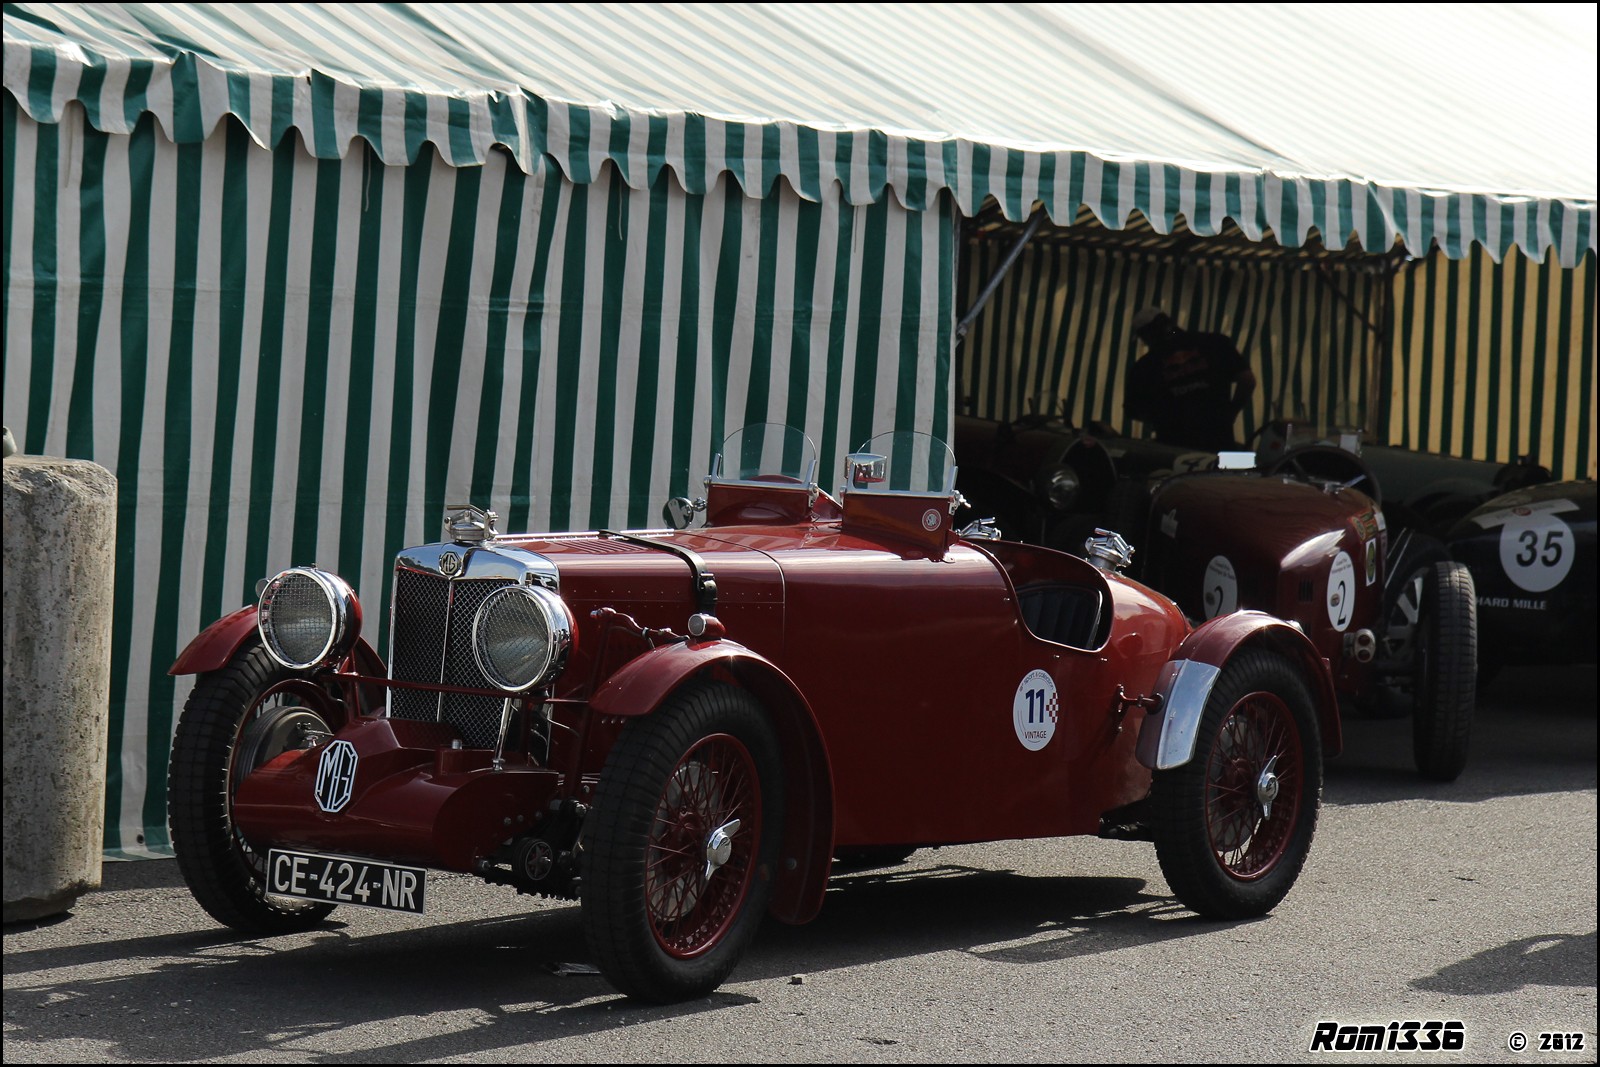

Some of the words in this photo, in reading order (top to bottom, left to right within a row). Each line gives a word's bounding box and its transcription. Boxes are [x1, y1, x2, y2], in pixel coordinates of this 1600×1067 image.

[442, 552, 459, 574] MG
[1516, 530, 1563, 567] 35
[1337, 580, 1347, 626] 2
[1475, 596, 1509, 608] HARD
[1512, 599, 1547, 610] MILLE
[1025, 689, 1045, 723] 11
[315, 740, 358, 812] MG
[274, 854, 417, 909] CE-424-NR
